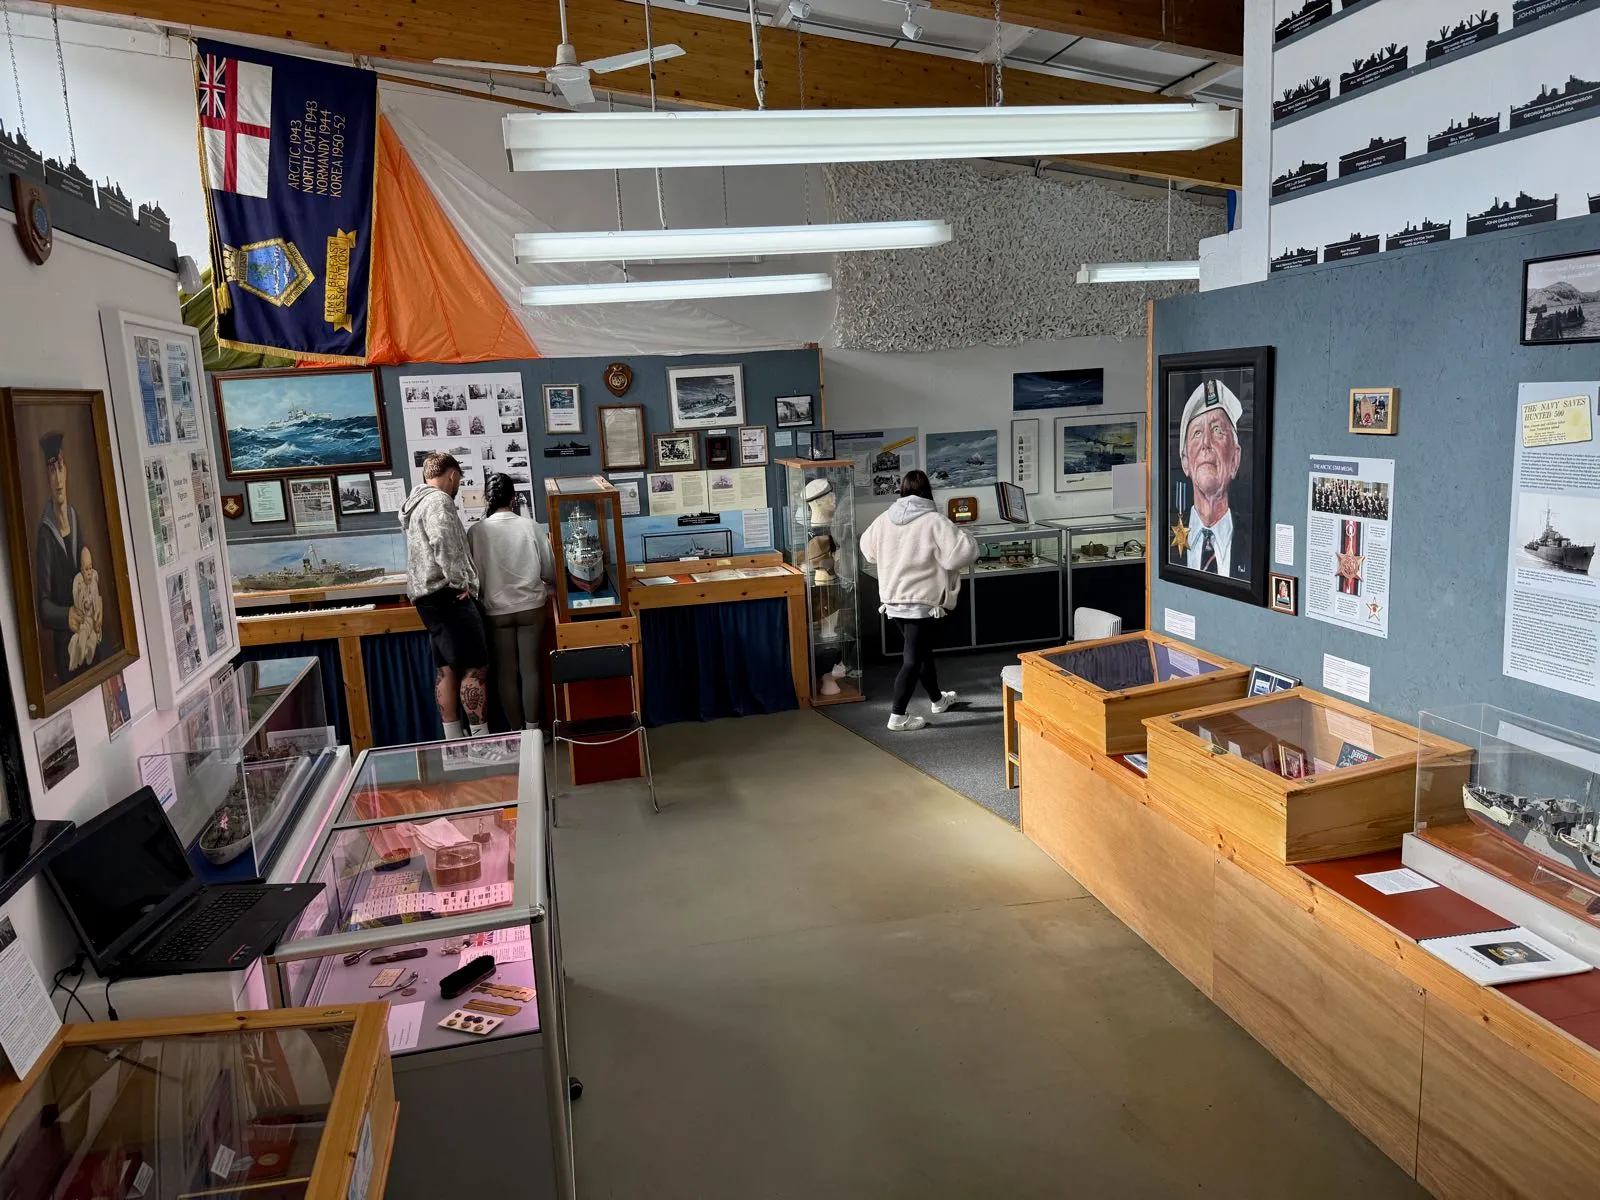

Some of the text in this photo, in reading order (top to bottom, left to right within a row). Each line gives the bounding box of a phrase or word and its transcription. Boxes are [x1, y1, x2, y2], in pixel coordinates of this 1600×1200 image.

[1516, 10, 1536, 20] JOHN
[1524, 95, 1592, 118] GEORGE WILLIAM ROBINSON
[288, 120, 302, 190] ARCTIC 1943
[302, 100, 318, 193] NORTH CAPE 1943
[316, 109, 332, 195] NORMANDY 1944
[330, 115, 346, 198] KOREA 1950-52
[327, 241, 339, 316] HMS BELFAST
[336, 248, 347, 314] ASSOCIATION
[1524, 398, 1586, 413] THE NAVY SAVES
[1525, 411, 1551, 421] HUNTED
